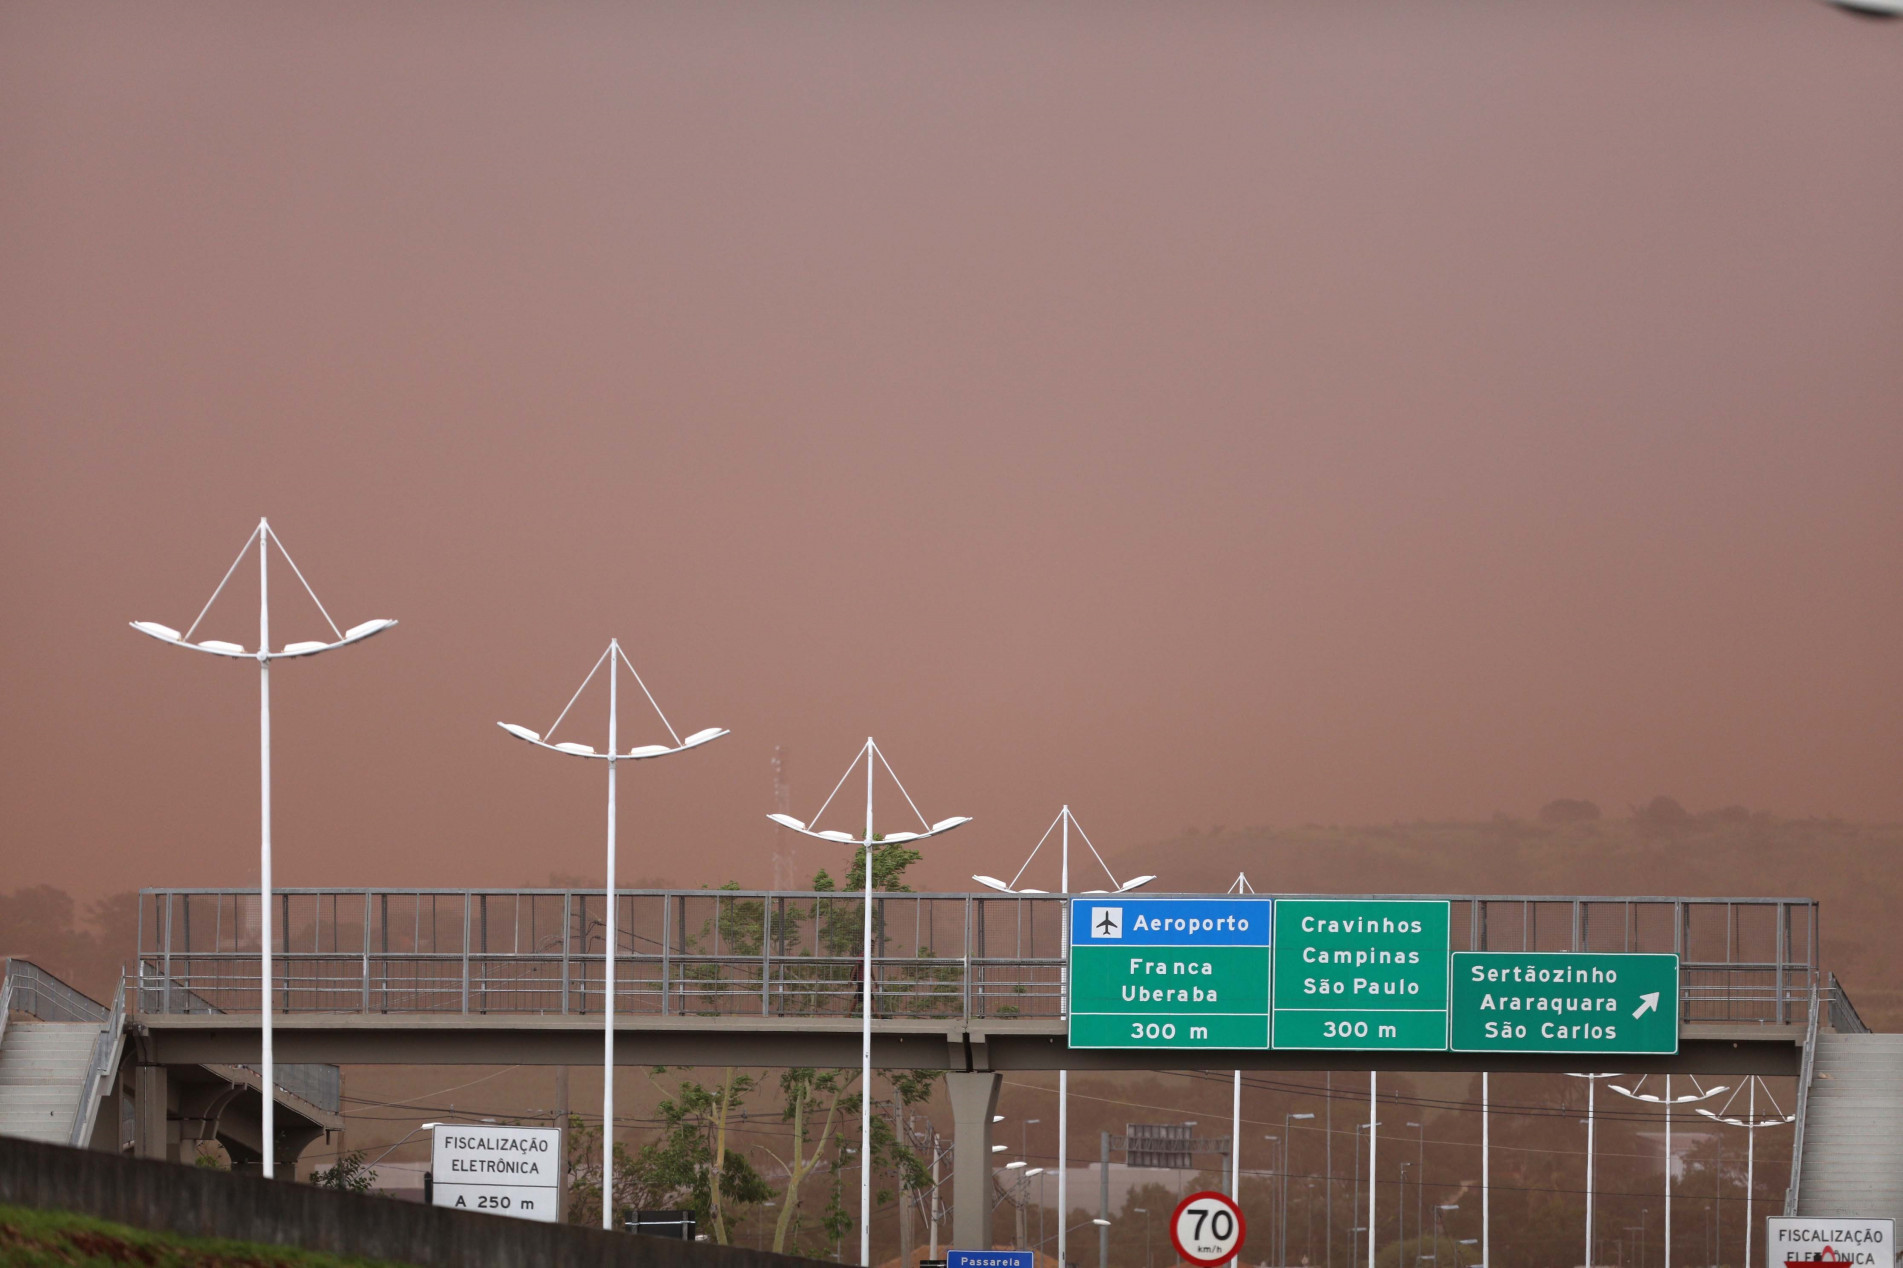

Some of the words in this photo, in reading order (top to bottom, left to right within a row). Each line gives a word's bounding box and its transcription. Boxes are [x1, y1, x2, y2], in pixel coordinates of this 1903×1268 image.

[1133, 914, 1250, 934] Aeroporto
[1301, 916, 1422, 934] Cravinhos
[1302, 946, 1420, 967] Campinas
[1130, 958, 1213, 976] Franca
[1471, 964, 1618, 984] Sertãozinho
[1121, 985, 1218, 1003] Uberaba
[1303, 976, 1345, 995] São
[1353, 977, 1420, 995] Paulo
[1480, 993, 1617, 1015] Araraquara
[1130, 1022, 1176, 1040] 300
[1189, 1026, 1208, 1040] m
[1323, 1020, 1369, 1038] 300
[1378, 1024, 1397, 1038] m
[1484, 1021, 1527, 1039] São
[1541, 1021, 1617, 1040] Carlos
[445, 1136, 549, 1155] FISCALIZAÇÃO
[451, 1158, 539, 1175] ELETRÔNICA
[455, 1195, 466, 1207] A
[477, 1196, 511, 1209] 250
[520, 1200, 534, 1210] m
[1187, 1209, 1234, 1241] 70
[1779, 1229, 1883, 1246] FISCALIZAÇÃO
[1197, 1245, 1222, 1253] km/h
[961, 1257, 1020, 1267] Passarela
